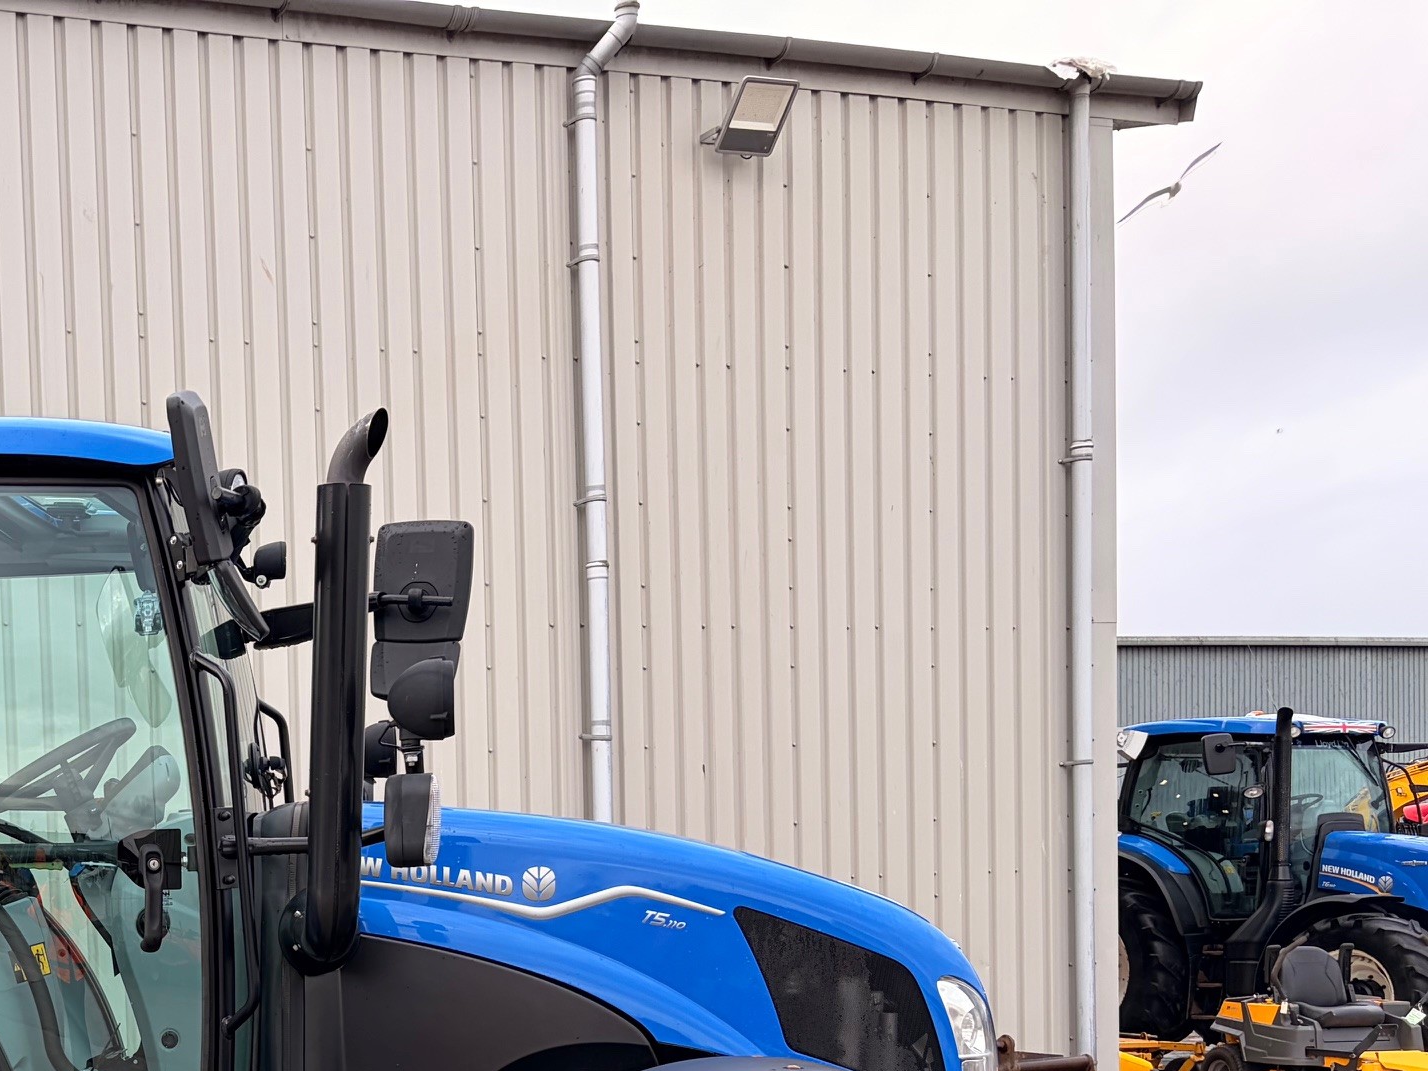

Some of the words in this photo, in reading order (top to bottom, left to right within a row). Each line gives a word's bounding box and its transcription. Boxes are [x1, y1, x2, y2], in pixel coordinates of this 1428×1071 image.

[390, 864, 513, 896] HOLLAND
[1322, 865, 1340, 874] NEW
[1341, 867, 1375, 884] HOLLAND
[642, 910, 687, 929] T5.110
